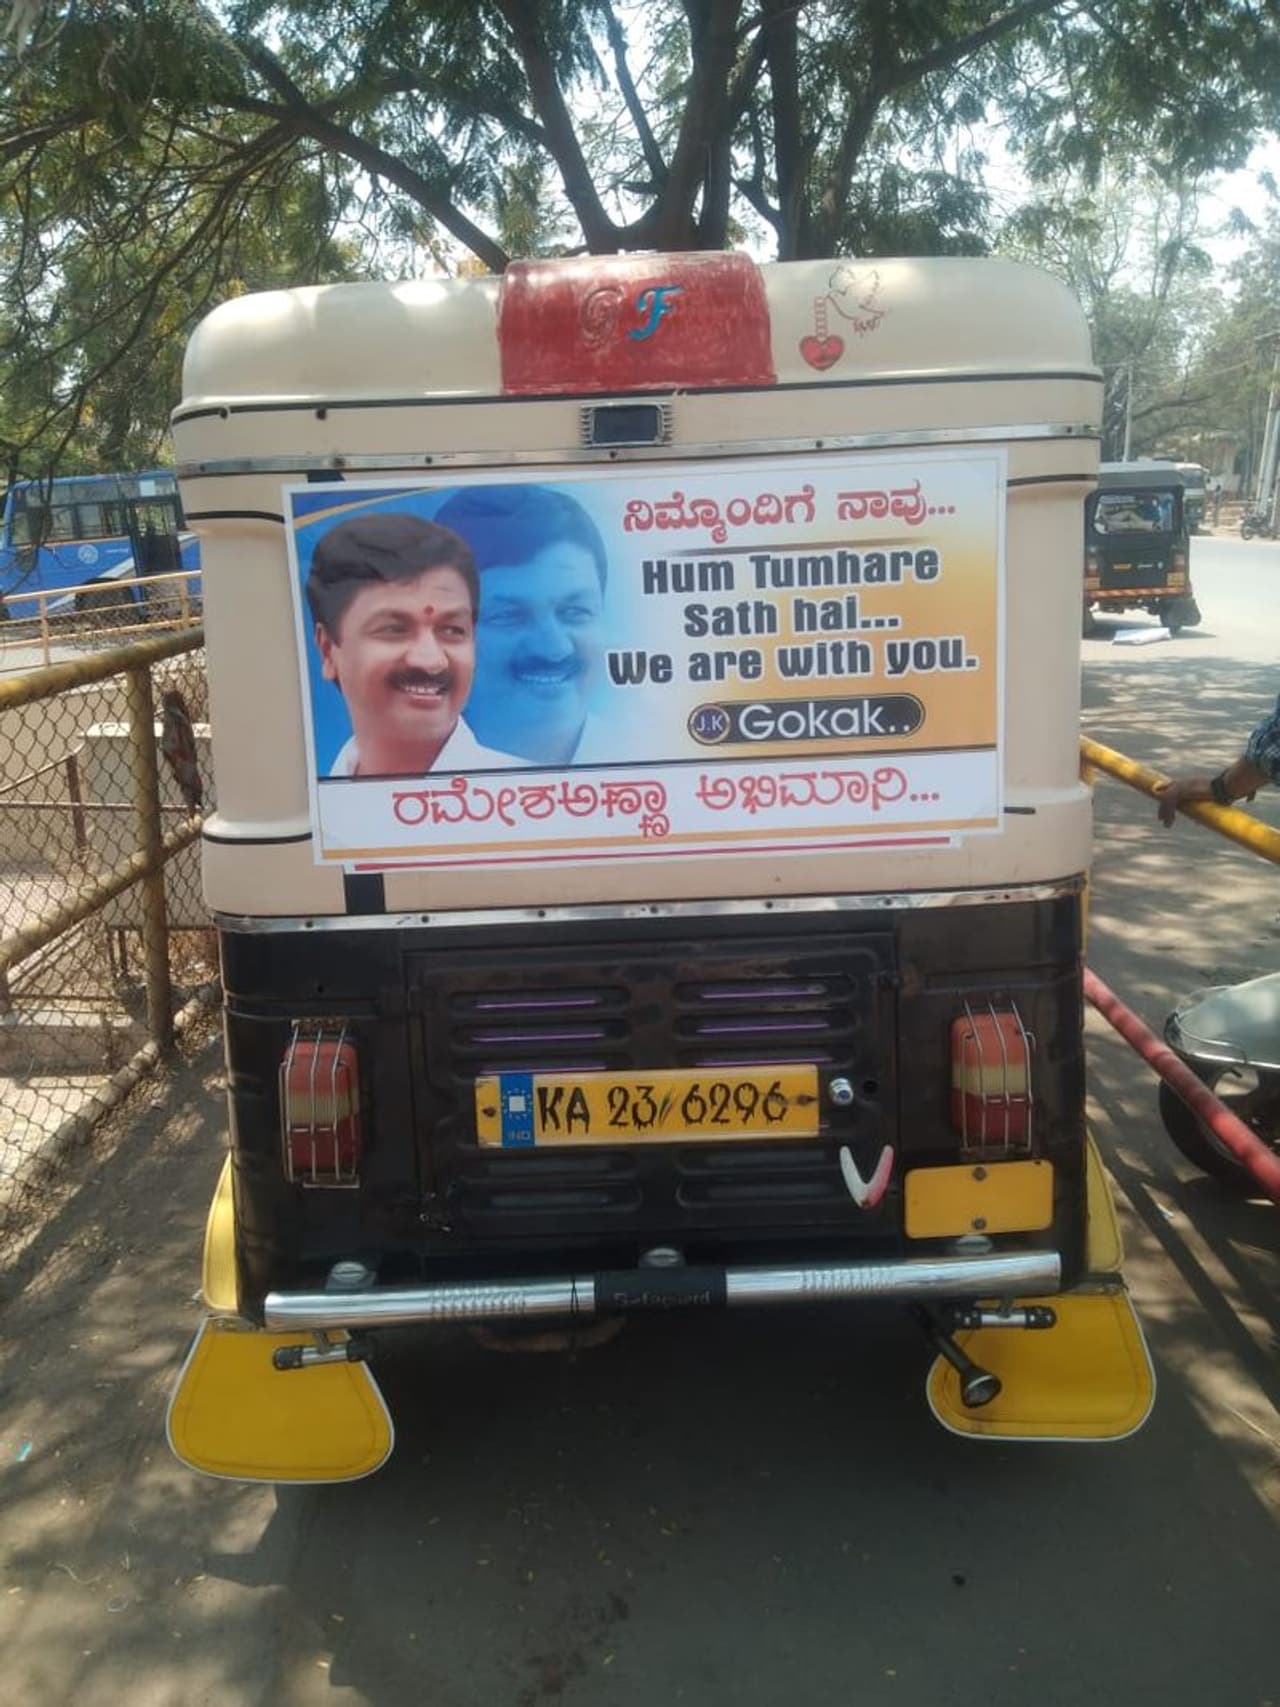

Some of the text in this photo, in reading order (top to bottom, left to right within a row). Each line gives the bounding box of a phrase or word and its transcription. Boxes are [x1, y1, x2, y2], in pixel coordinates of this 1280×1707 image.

[642, 549, 939, 595] Hum Tumhare
[684, 596, 899, 638] Sath hai...
[608, 638, 977, 685] We are with you.
[696, 699, 910, 740] J.K Gokak..
[696, 767, 940, 815] ಅಭಿಮಾನಿ...
[537, 1087, 590, 1134] KA
